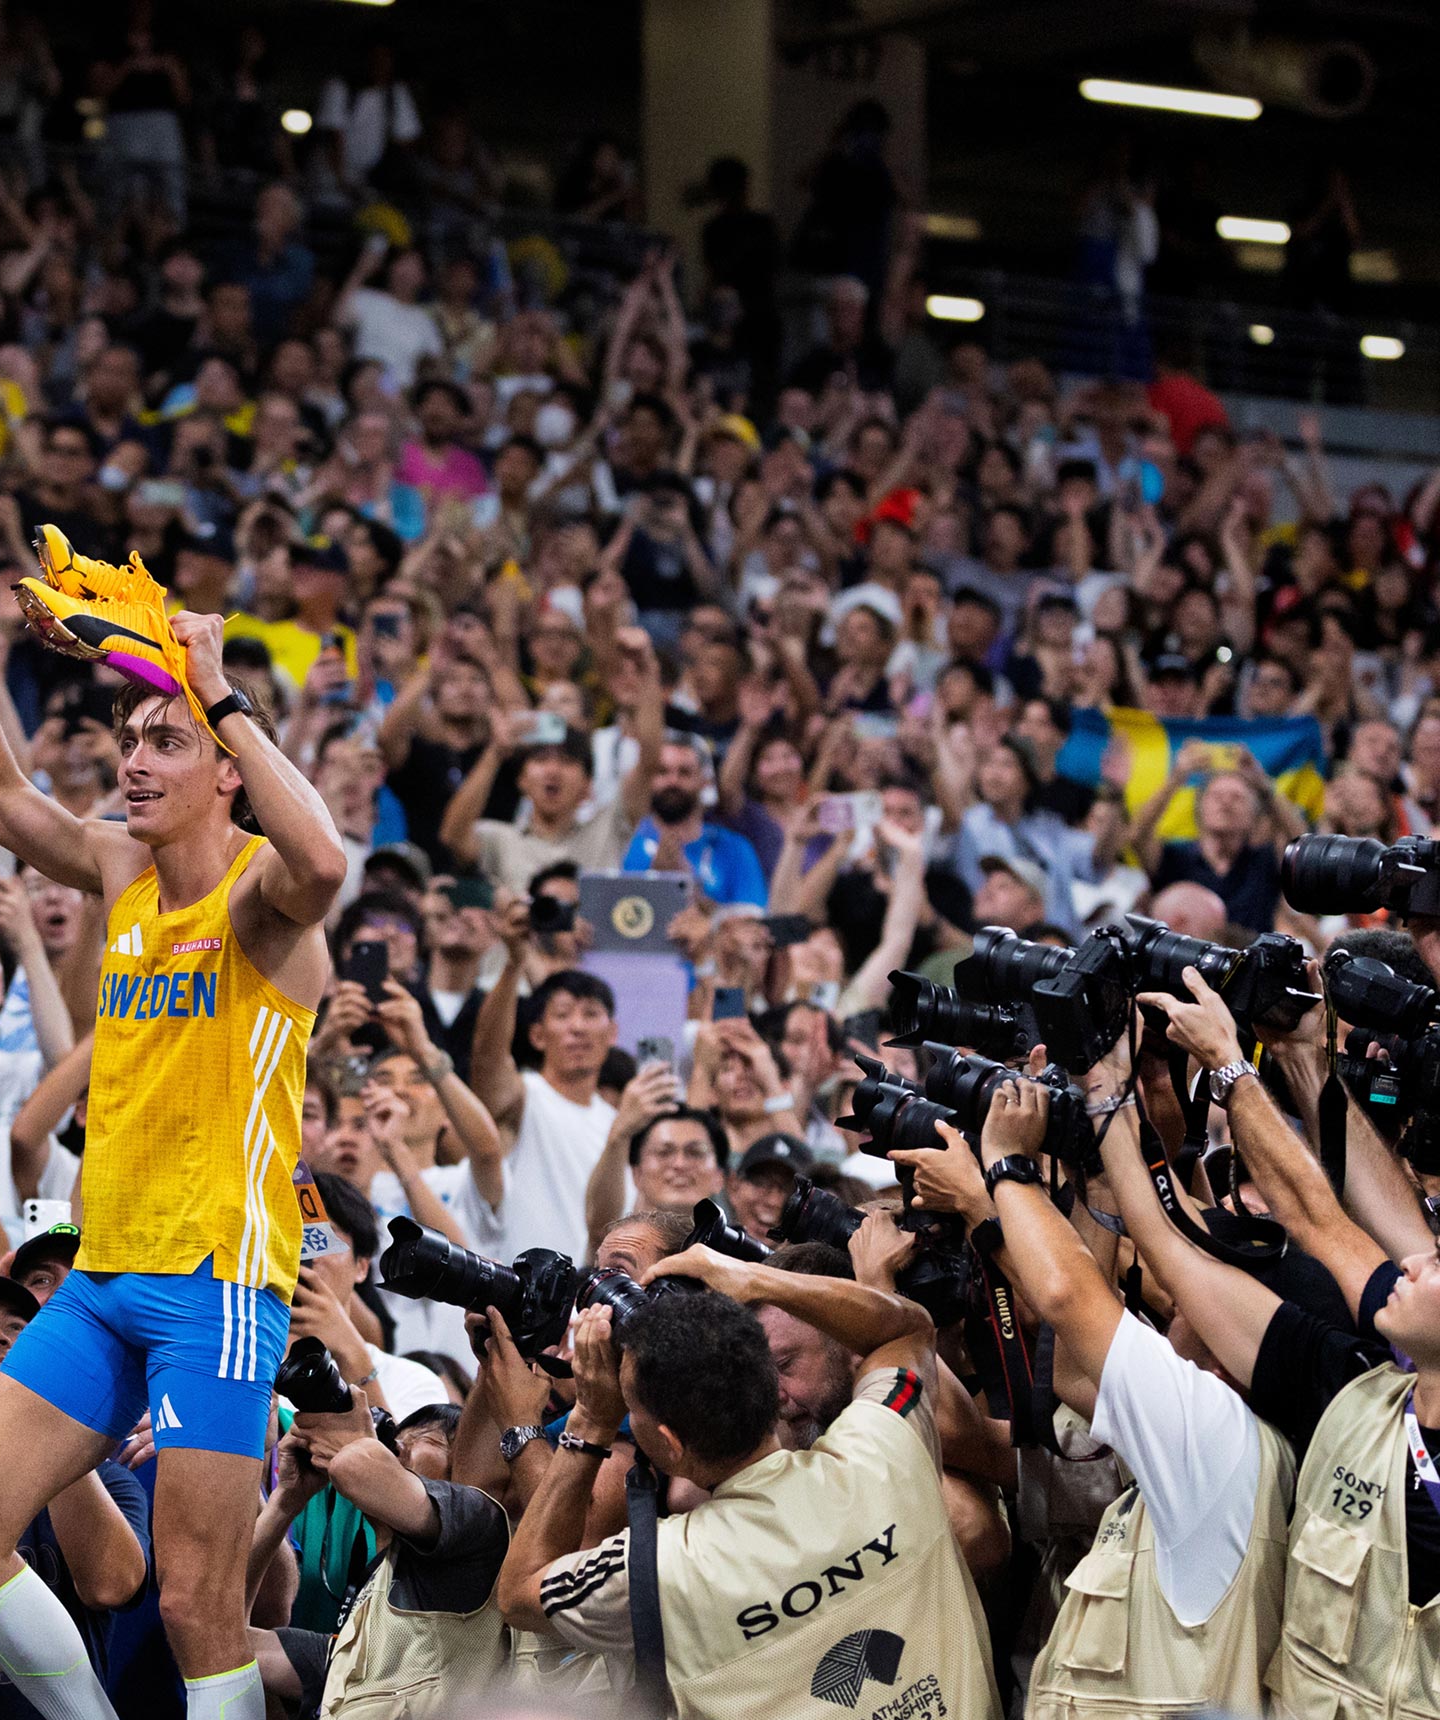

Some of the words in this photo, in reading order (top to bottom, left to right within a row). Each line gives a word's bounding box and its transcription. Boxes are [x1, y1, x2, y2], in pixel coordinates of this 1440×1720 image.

[173, 939, 221, 955] BAUHAUS
[99, 972, 217, 1020] SWEDEN
[994, 1287, 1015, 1340] Canon
[1332, 1487, 1374, 1520] 129
[1333, 1465, 1387, 1500] SONY
[736, 1523, 899, 1641] SONY
[872, 1674, 938, 1720] ATHLETICS
